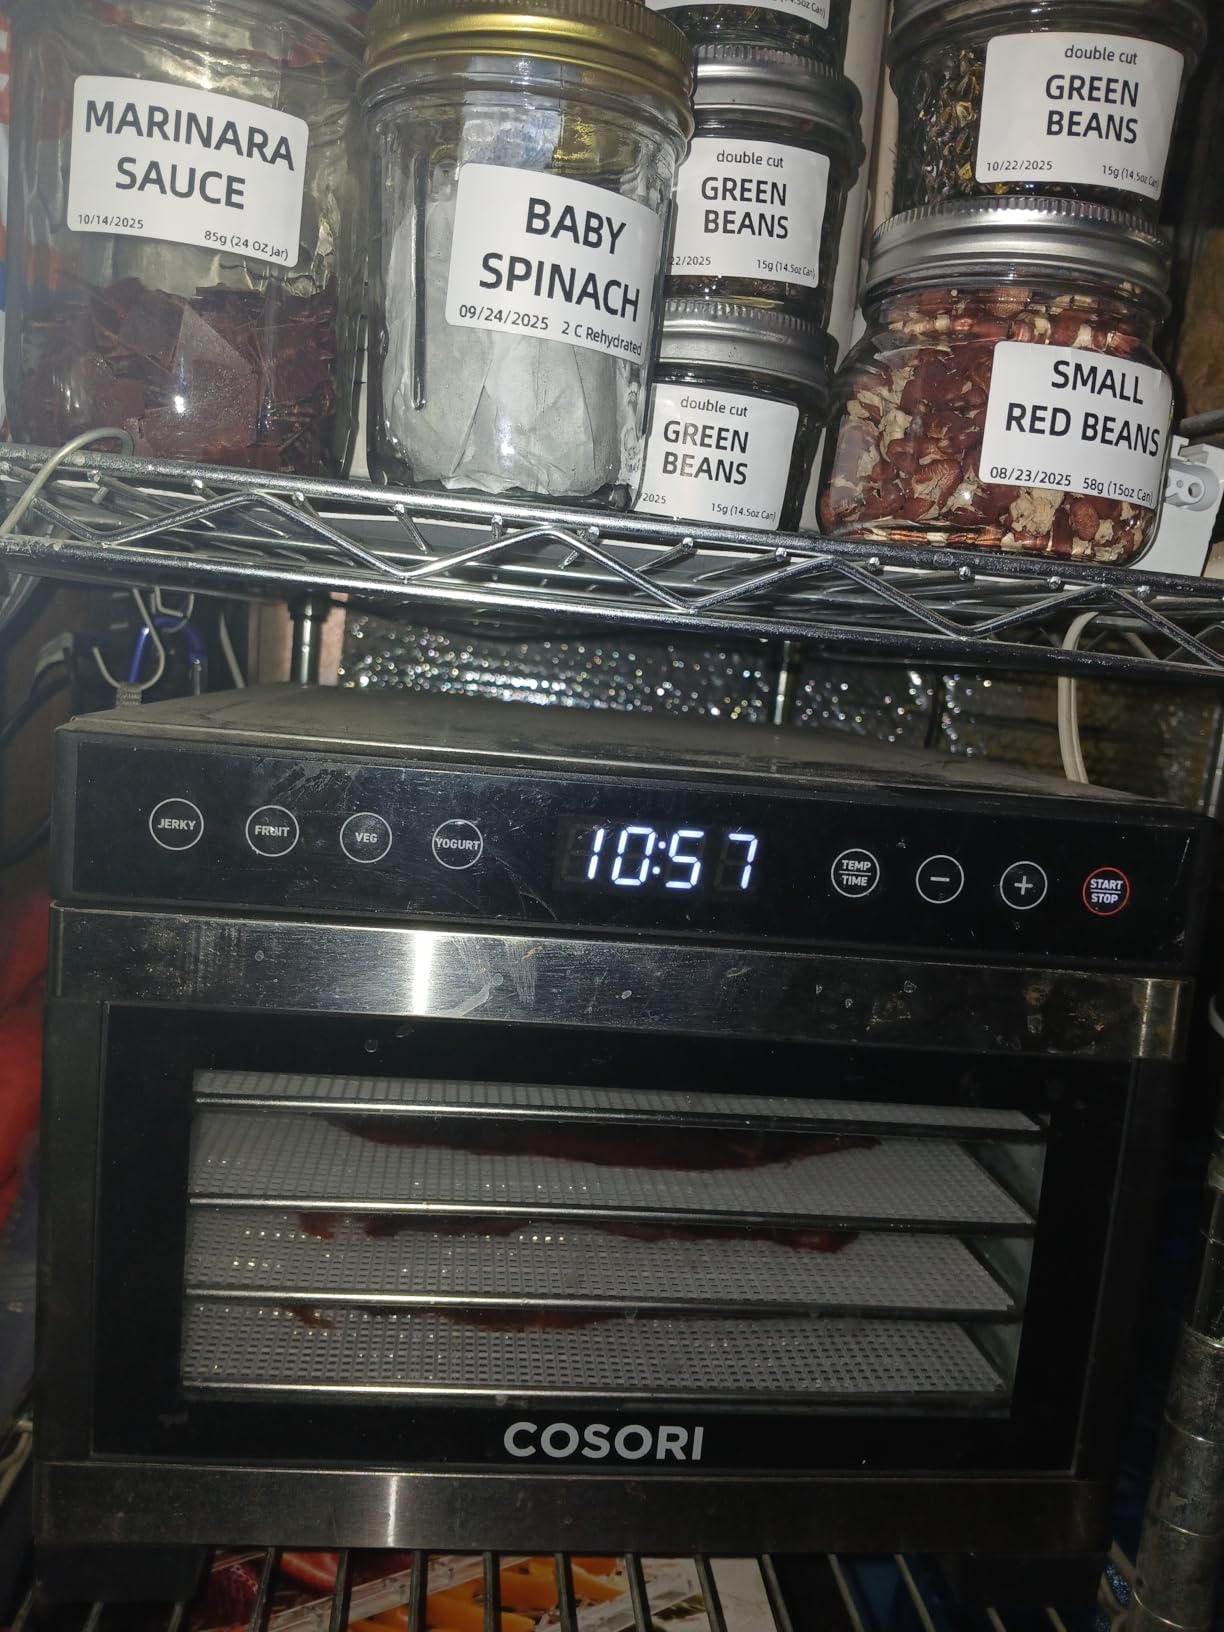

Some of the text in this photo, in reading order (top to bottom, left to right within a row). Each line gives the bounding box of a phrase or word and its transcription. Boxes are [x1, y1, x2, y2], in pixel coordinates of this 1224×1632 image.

[1064, 44, 1138, 65] double cut
[1045, 74, 1139, 107] GREEN
[85, 100, 295, 171] MARINARA
[1046, 110, 1138, 144] BEANS
[716, 149, 784, 169] double cut
[986, 160, 1053, 171] 10/22/2025
[115, 156, 246, 210] SAUCE
[1103, 165, 1120, 179] 15g
[1121, 168, 1148, 184] (14.5oz
[701, 176, 787, 207] GREEN
[77, 214, 144, 230] 10/14/2025
[525, 197, 627, 255] BABY
[703, 209, 789, 239] BEANS
[204, 230, 228, 246] 85g
[230, 235, 249, 249] (24
[269, 245, 289, 262] Jar)
[670, 256, 712, 266] 22/2025
[757, 260, 774, 272] 15g
[775, 261, 802, 275] (14.5oz
[479, 252, 640, 322] SPINACH
[459, 304, 643, 357] 09/24/2025 2 C Rehydrated
[1051, 360, 1144, 405] SMALL
[680, 395, 748, 418] double cut
[663, 420, 749, 454] GREEN
[1005, 402, 1160, 457] RED BEANS
[662, 451, 748, 485] BEANS
[990, 466, 1153, 506] 08/23/2025 58g (15oz Can)
[641, 492, 667, 504] 2025
[711, 502, 776, 521] 15g (14.5oz Can)
[157, 818, 197, 831] JERKY
[254, 825, 290, 837] FRUIT
[355, 832, 378, 843] VEG
[435, 838, 481, 851] YOGURT
[587, 826, 758, 889] 10:57
[841, 859, 872, 872] TEMP
[841, 875, 868, 887] TIME
[1090, 878, 1123, 891] START
[1090, 893, 1119, 904] STOP
[503, 1421, 704, 1460] COSORI
